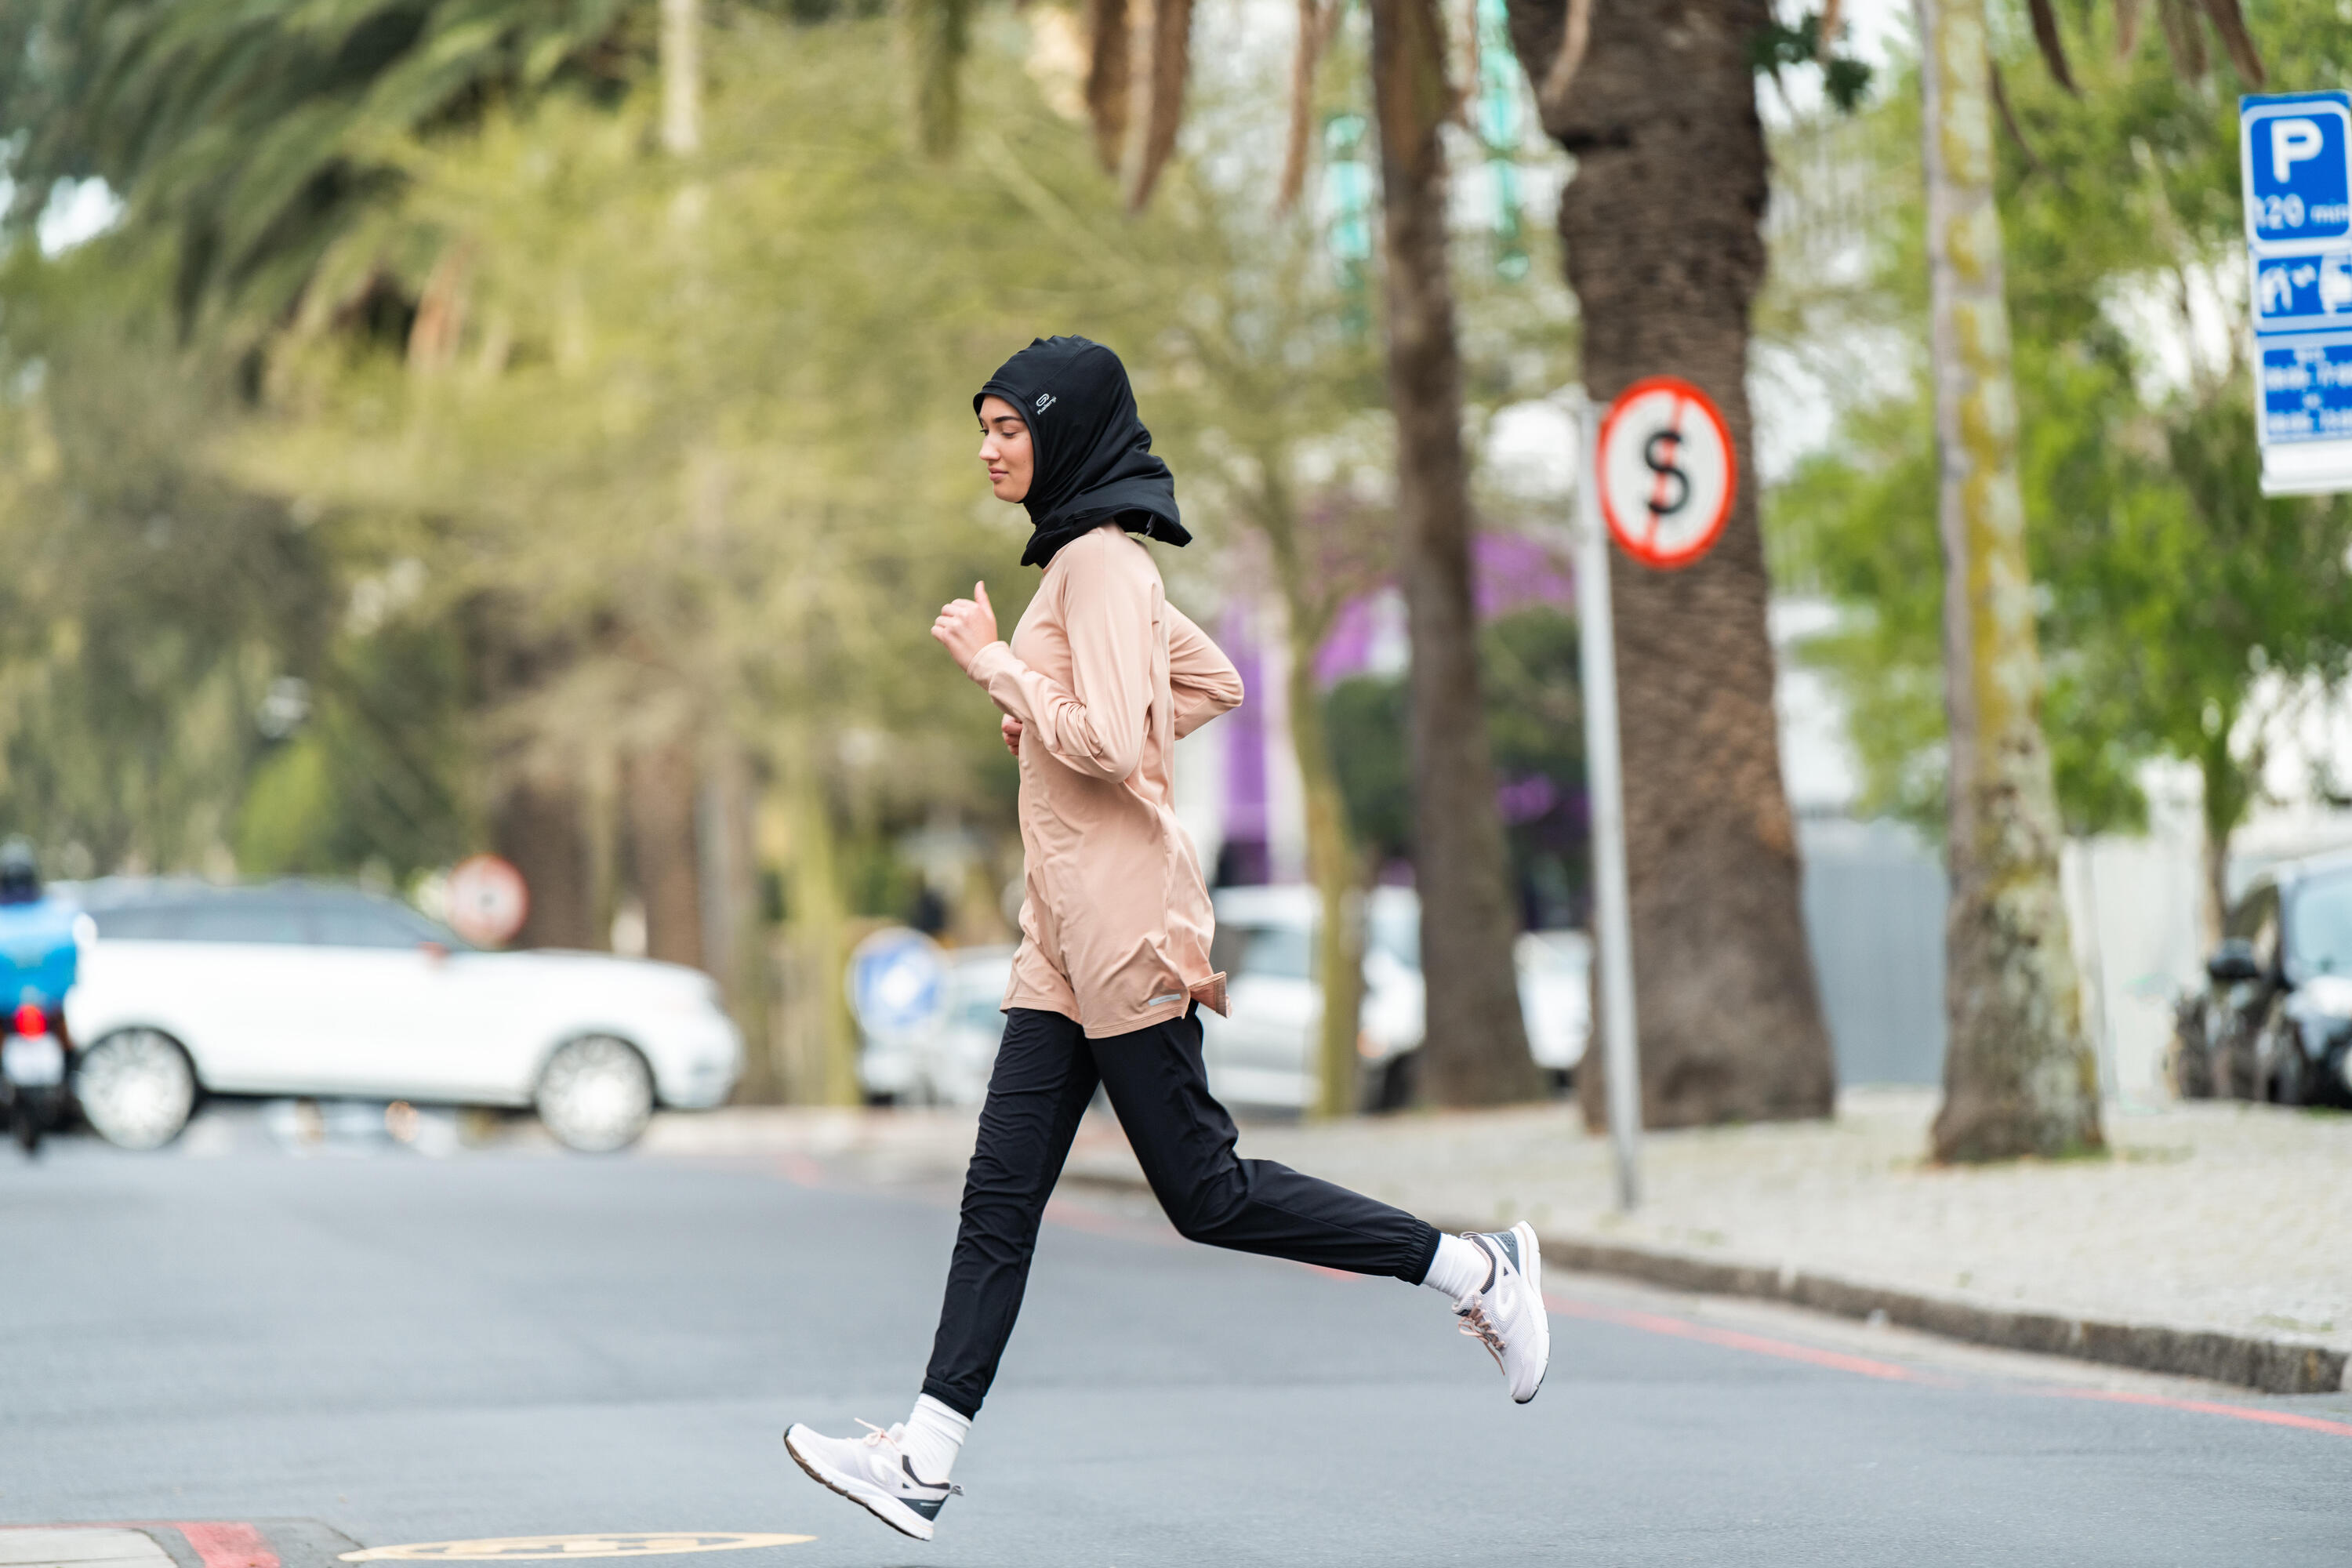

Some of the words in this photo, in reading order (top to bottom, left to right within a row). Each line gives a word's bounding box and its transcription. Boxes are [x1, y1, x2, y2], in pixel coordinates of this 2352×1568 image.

[2271, 118, 2323, 183] P
[2253, 194, 2305, 230] 120
[1644, 430, 1690, 516] S
